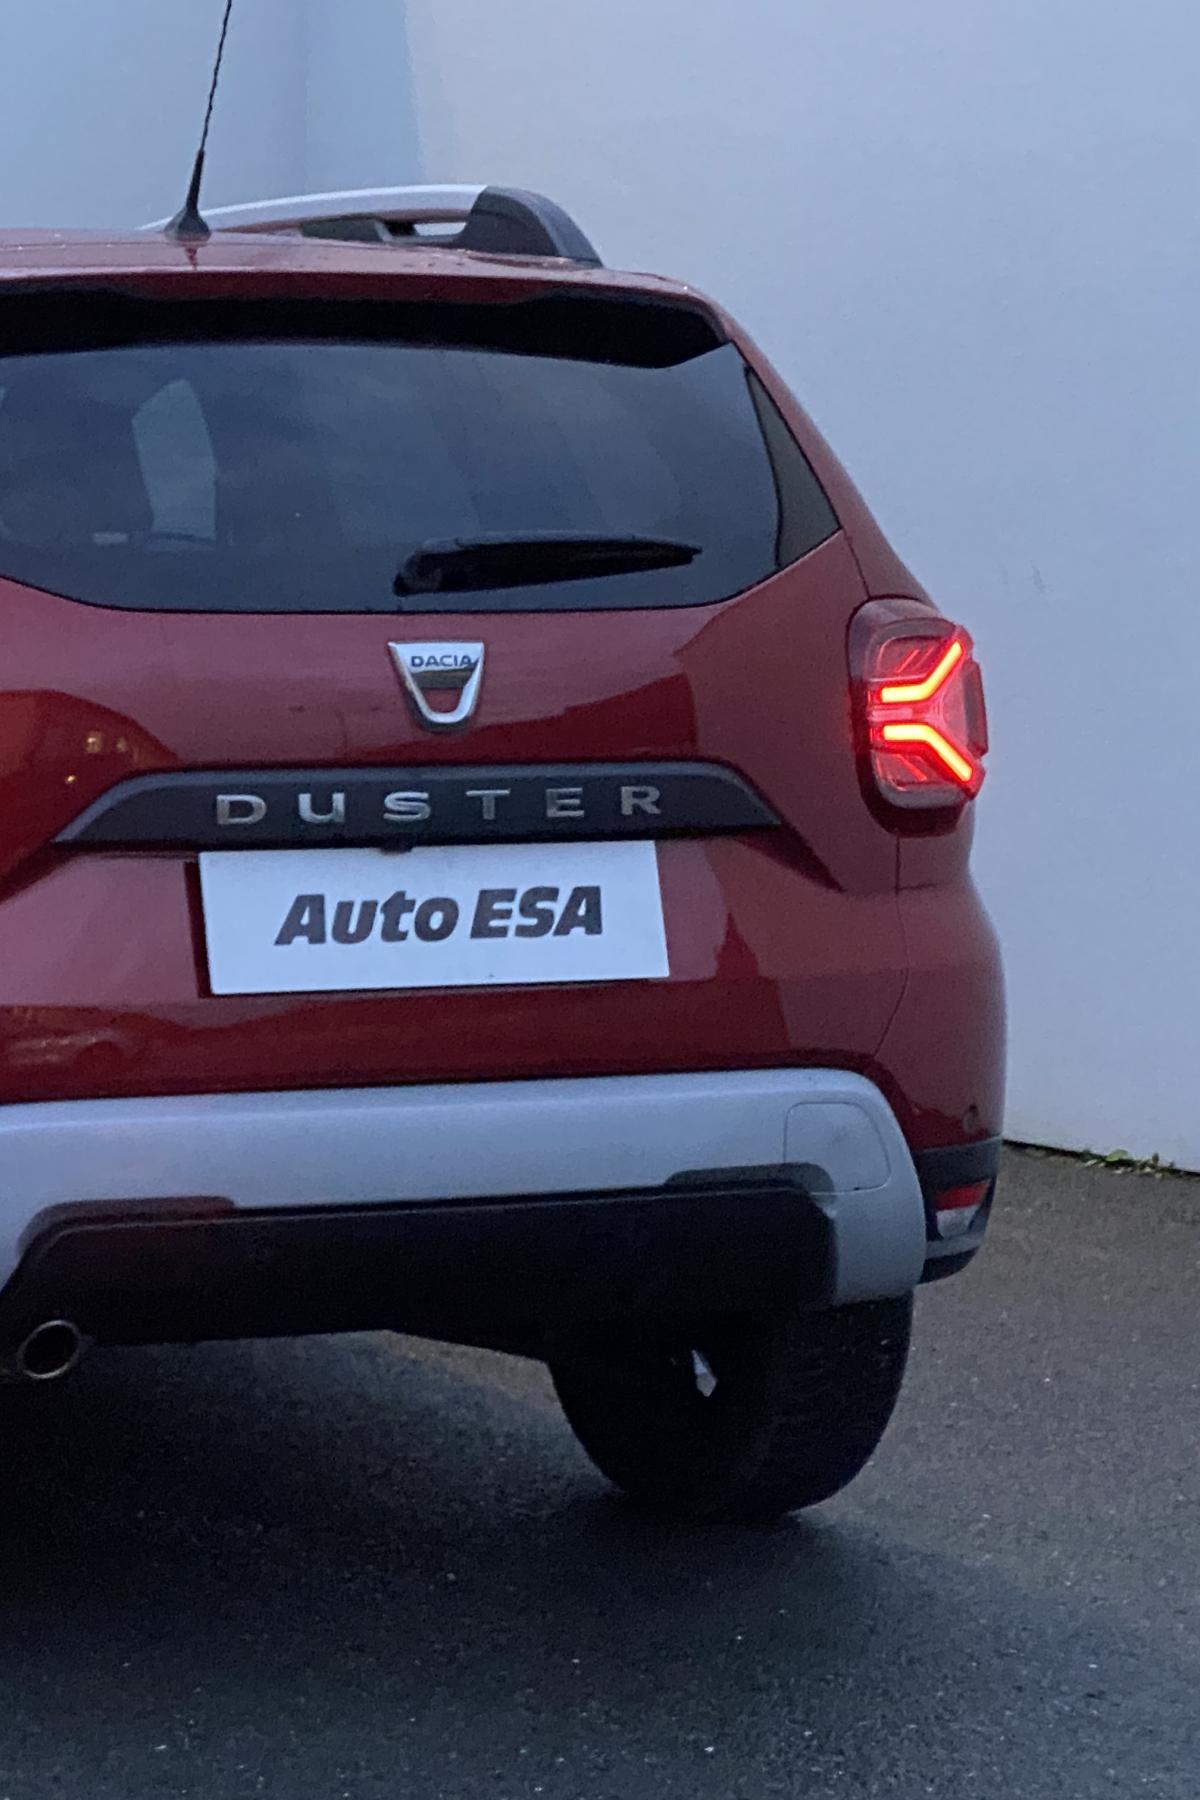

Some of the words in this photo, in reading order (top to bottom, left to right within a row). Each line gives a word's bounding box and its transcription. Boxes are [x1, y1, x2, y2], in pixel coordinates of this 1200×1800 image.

[411, 655, 473, 668] DACIA
[216, 786, 662, 825] DUSTER
[274, 891, 460, 946] Auto
[471, 886, 604, 939] ESA
